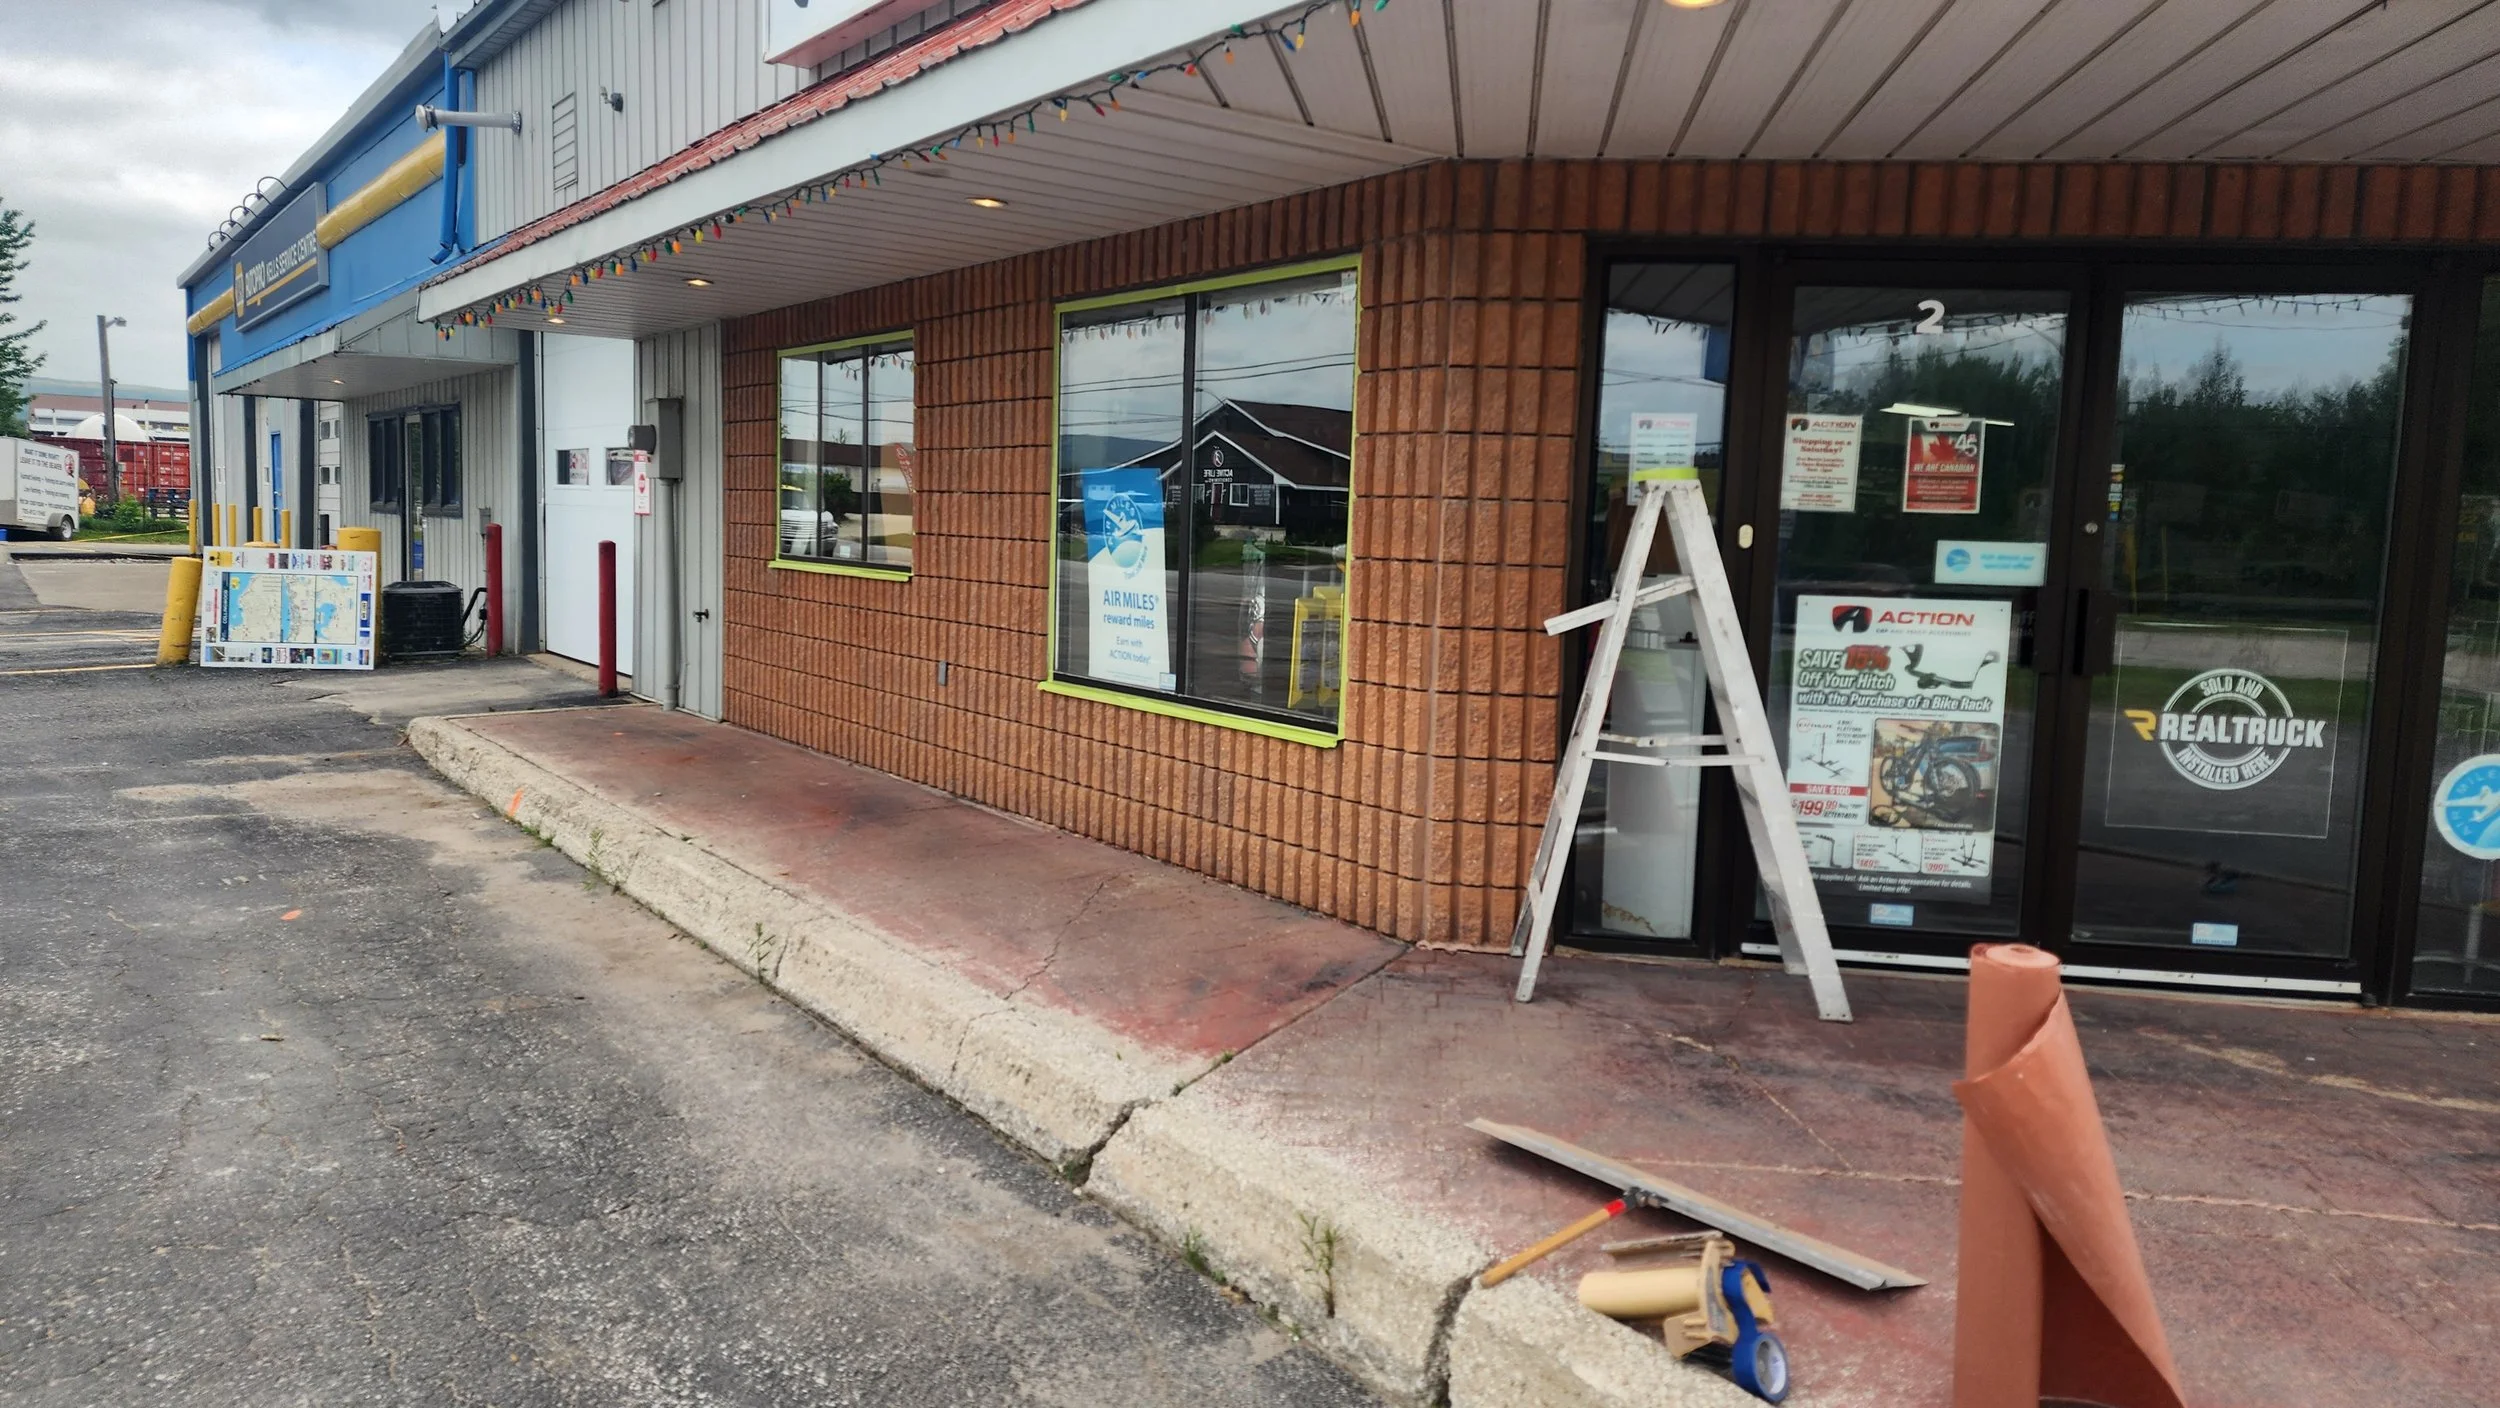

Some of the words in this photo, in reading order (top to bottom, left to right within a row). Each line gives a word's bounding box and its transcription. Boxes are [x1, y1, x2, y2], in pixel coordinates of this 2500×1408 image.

[279, 243, 298, 274] SERVICE
[297, 229, 317, 262] CENTRE
[1916, 299, 1945, 334] 2
[1793, 437, 1833, 446] Shopping
[1955, 433, 1977, 457] 45
[1926, 464, 1938, 472] ARE
[1940, 464, 1975, 472] CANADIAN
[1103, 589, 1121, 607] AIR
[1103, 613, 1132, 626] reward
[1133, 615, 1155, 629] miles
[1879, 610, 1976, 626] ACTION
[1116, 635, 1130, 646] Earn
[1130, 638, 1143, 648] with
[1109, 649, 1132, 661] ACTION
[1799, 649, 1842, 670] SAVE
[1799, 672, 1822, 688] Off
[1824, 673, 1858, 690] Your
[1859, 675, 1895, 691] Hitch
[2200, 676, 2233, 697] SOLD
[2235, 677, 2265, 699] AND
[1799, 692, 1826, 706] with
[1828, 693, 1850, 706] the
[1851, 694, 1906, 709] Purchase
[1908, 695, 1921, 711] of
[1921, 699, 1931, 711] a
[1933, 697, 1962, 712] Bike
[1962, 699, 1992, 713] Rack
[2159, 712, 2327, 748] REALTRUCK
[2176, 747, 2240, 784] INSTALLED
[2239, 752, 2275, 780] HERE
[1806, 785, 1827, 794] SAVE
[2456, 769, 2498, 794] MILE
